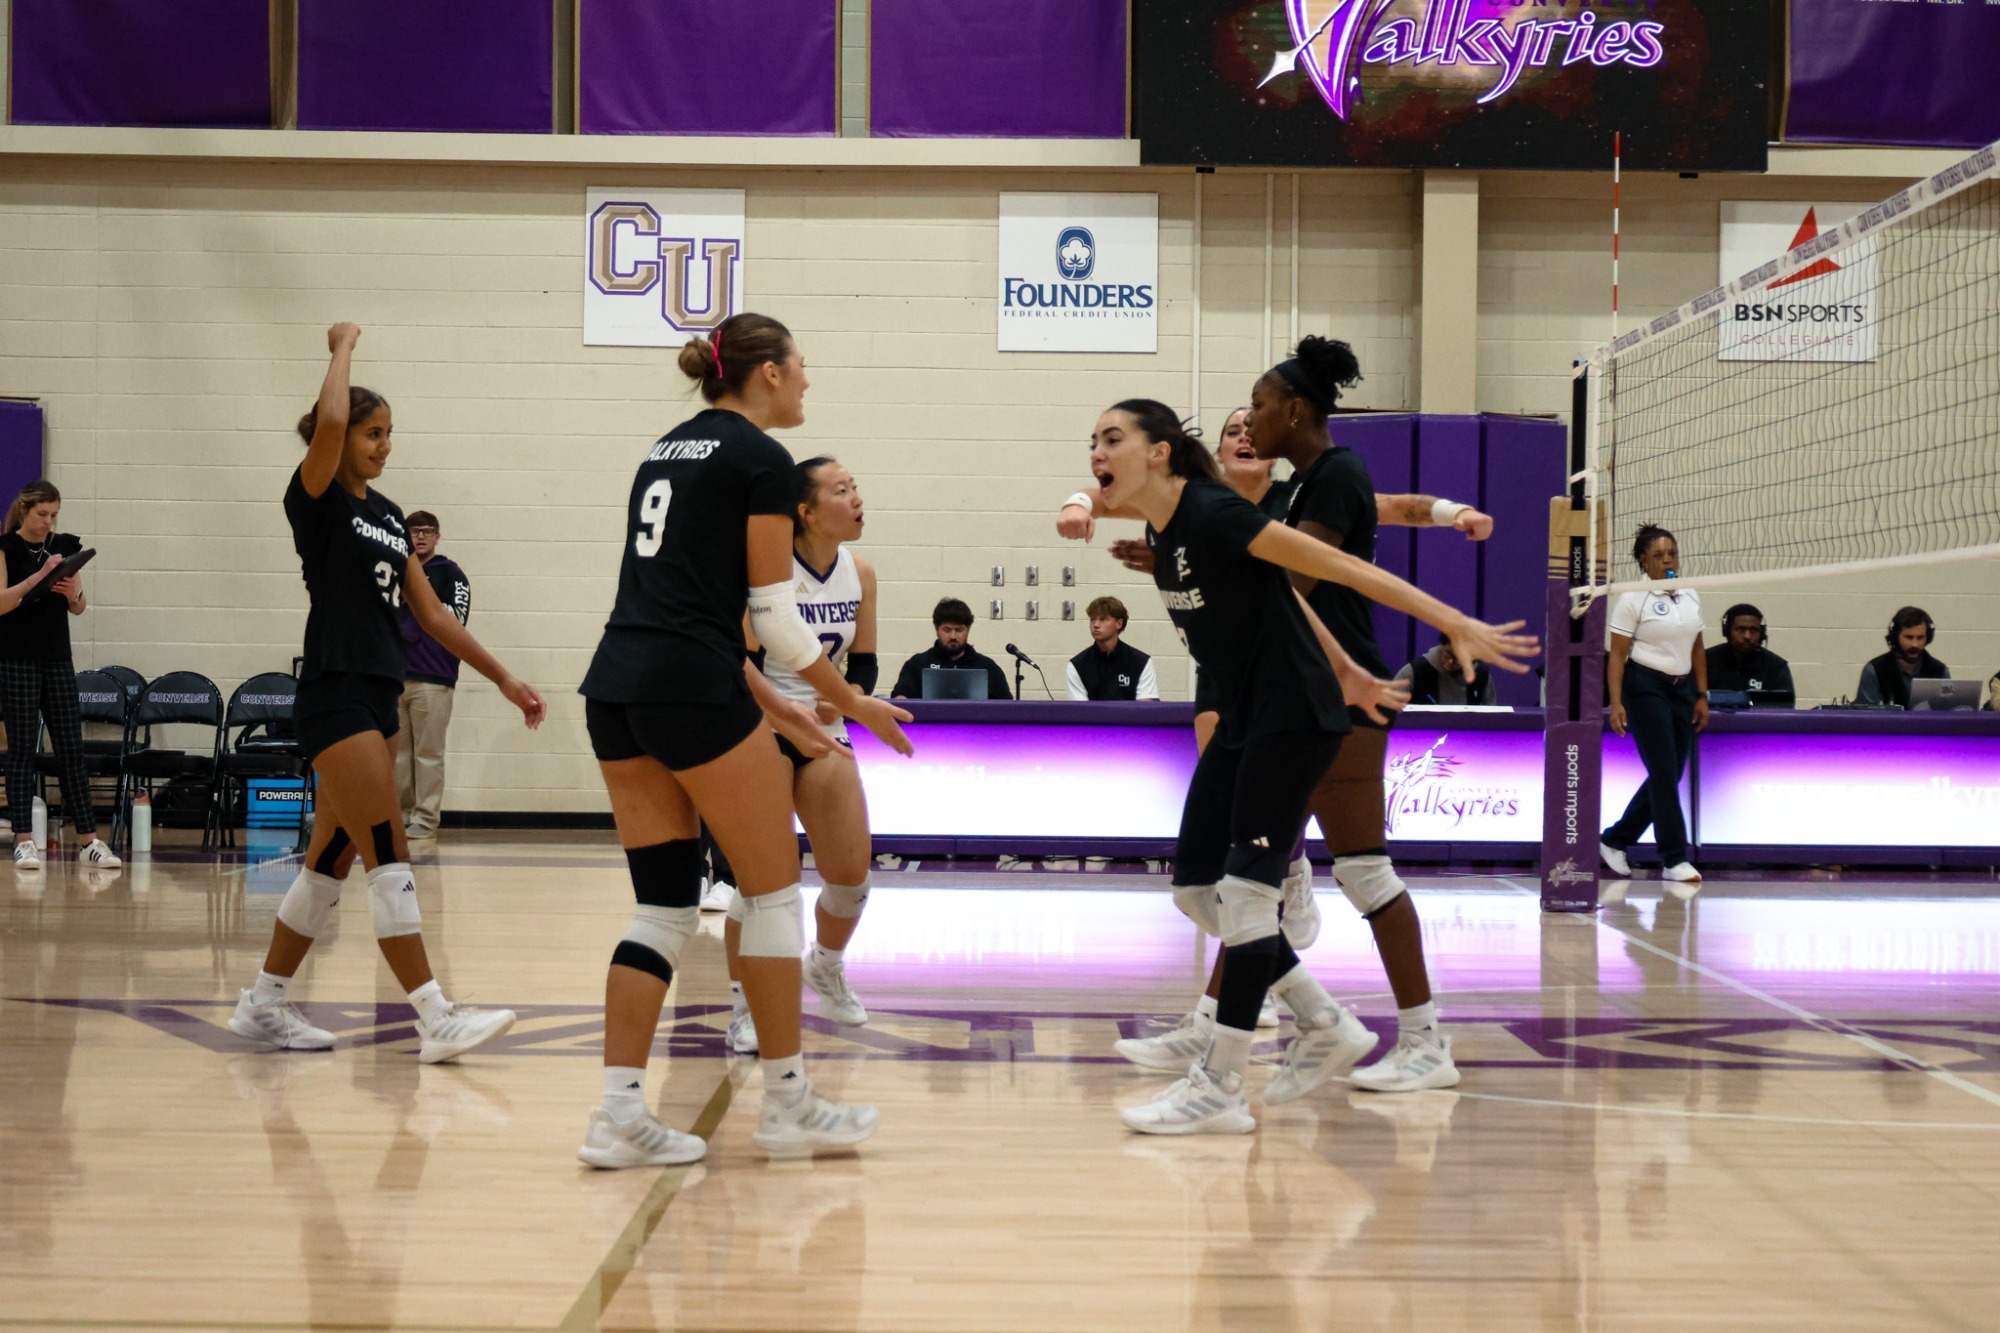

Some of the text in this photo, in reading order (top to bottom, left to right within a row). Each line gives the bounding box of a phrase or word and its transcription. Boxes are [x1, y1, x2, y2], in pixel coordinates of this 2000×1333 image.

[1286, 0, 1665, 121] Valkyries
[589, 201, 740, 332] CU
[1004, 278, 1153, 308] FOUNDERS
[1004, 310, 1058, 318] FEDERAL
[1064, 310, 1108, 318] CREDIT
[1735, 304, 1863, 322] BSN SPORTS
[645, 440, 721, 461] ALKYRIES
[635, 479, 673, 558] 9
[796, 600, 861, 624] ONVERS
[78, 692, 118, 702] VERSE
[148, 692, 211, 703] CONVERSE
[240, 694, 296, 704] CONVERS
[1564, 744, 1579, 844] sports imports
